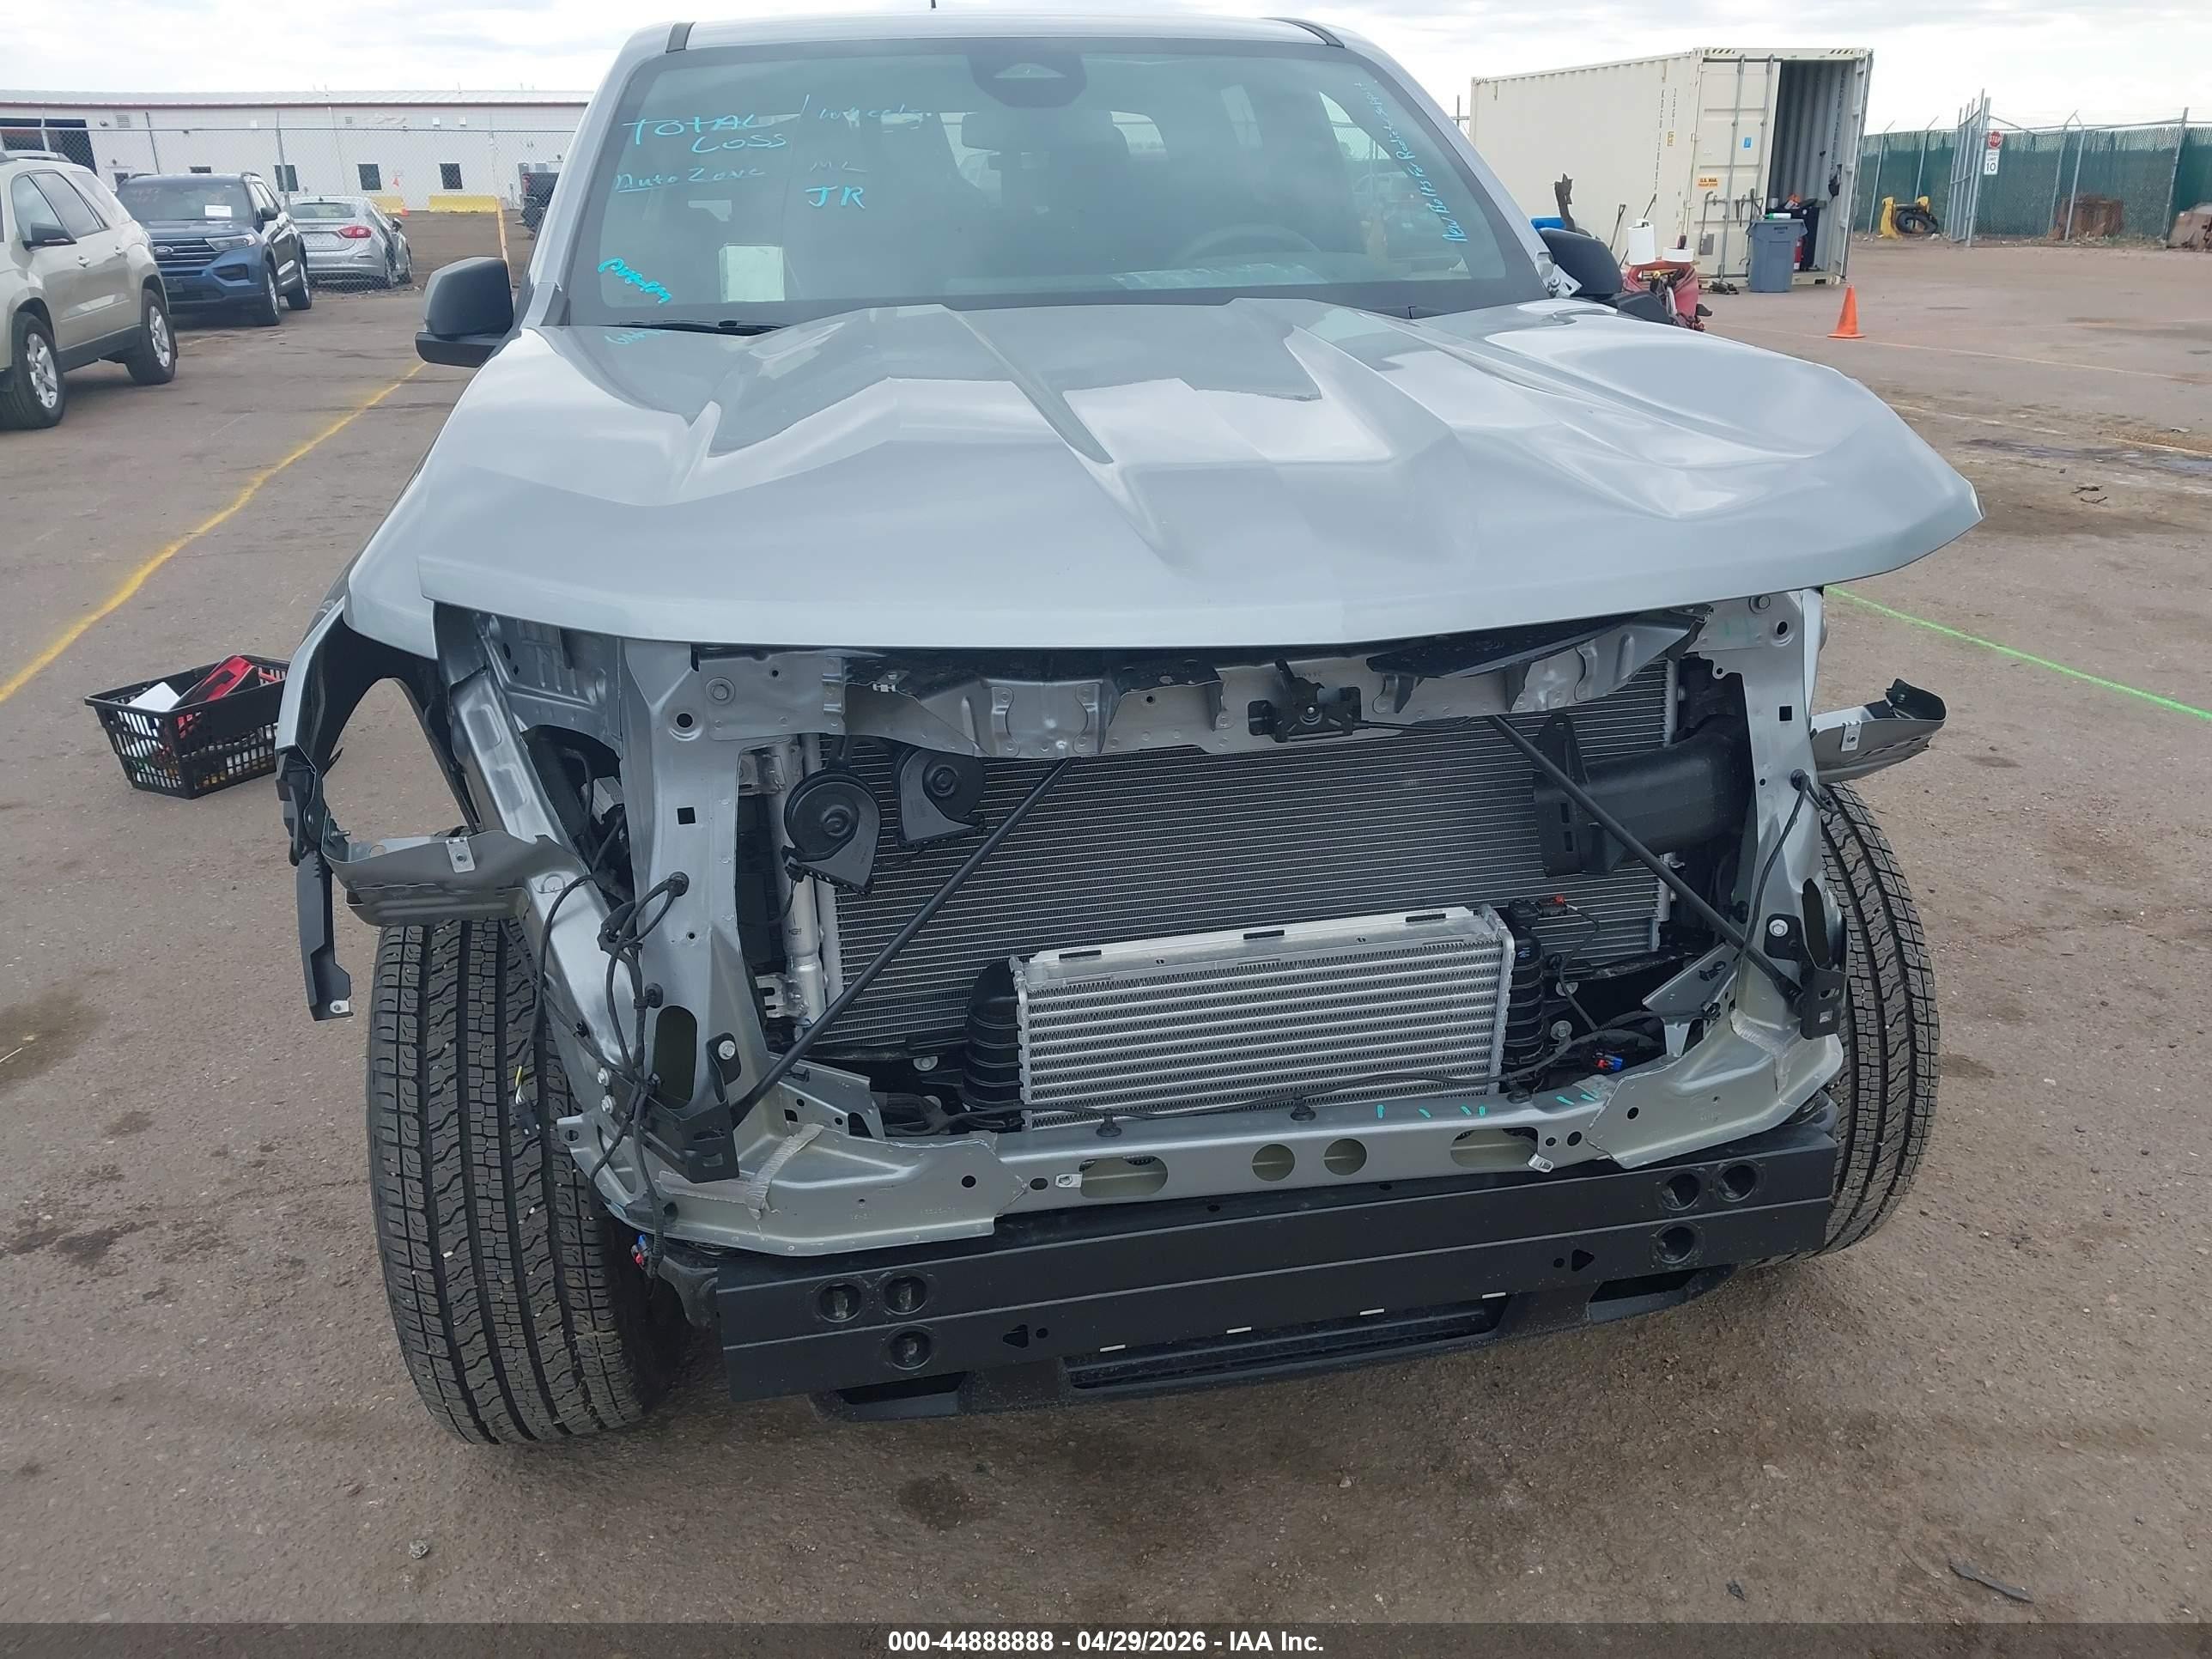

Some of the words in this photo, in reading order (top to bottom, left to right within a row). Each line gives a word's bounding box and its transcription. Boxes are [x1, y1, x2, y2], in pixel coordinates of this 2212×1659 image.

[621, 113, 770, 145] TOTAL
[690, 133, 787, 154] LOSS
[1986, 162, 1996, 173] 10
[805, 185, 866, 210] JR
